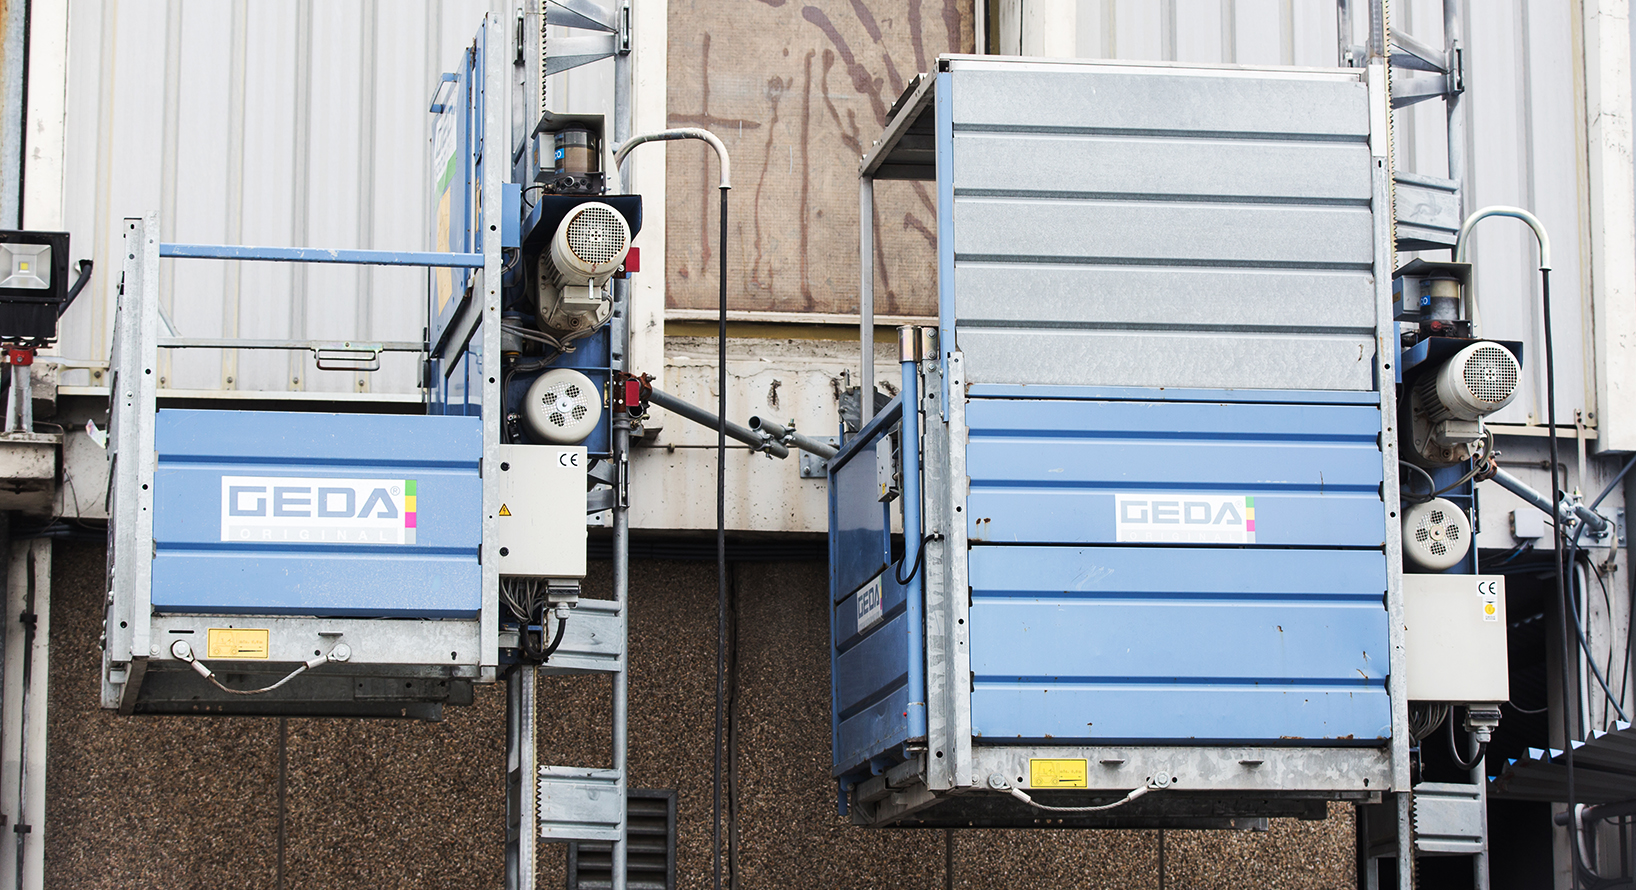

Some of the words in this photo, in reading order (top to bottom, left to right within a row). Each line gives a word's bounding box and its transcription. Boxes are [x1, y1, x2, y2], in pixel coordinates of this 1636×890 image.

[559, 453, 579, 467] CE
[240, 528, 388, 541] ORIGINAL
[1129, 531, 1236, 541] ORIGINAL
[1477, 581, 1496, 595] CE
[857, 583, 880, 620] GEDA
